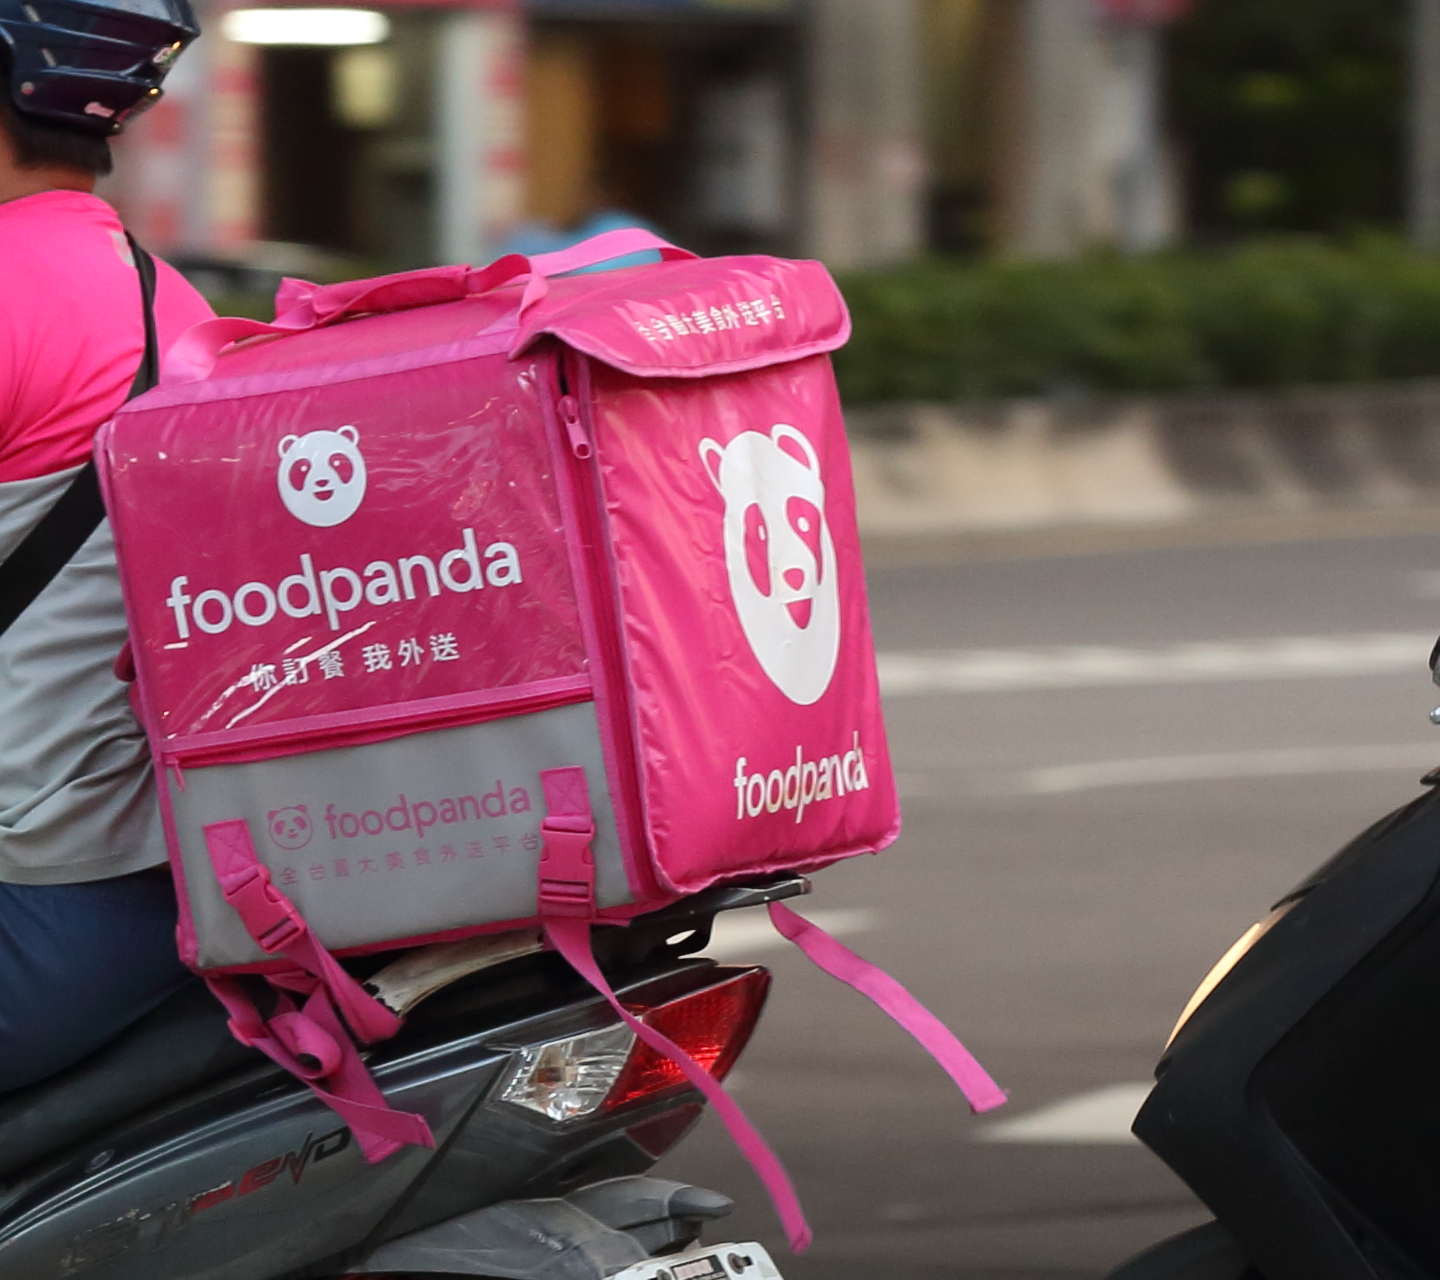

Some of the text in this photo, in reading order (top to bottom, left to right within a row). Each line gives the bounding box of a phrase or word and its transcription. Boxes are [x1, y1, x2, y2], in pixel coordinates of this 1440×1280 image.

[166, 528, 523, 639] foodpanda
[249, 633, 460, 691] 你訂餐 我外送
[324, 779, 531, 839] foodpanda
[733, 731, 869, 824] foodpanda
